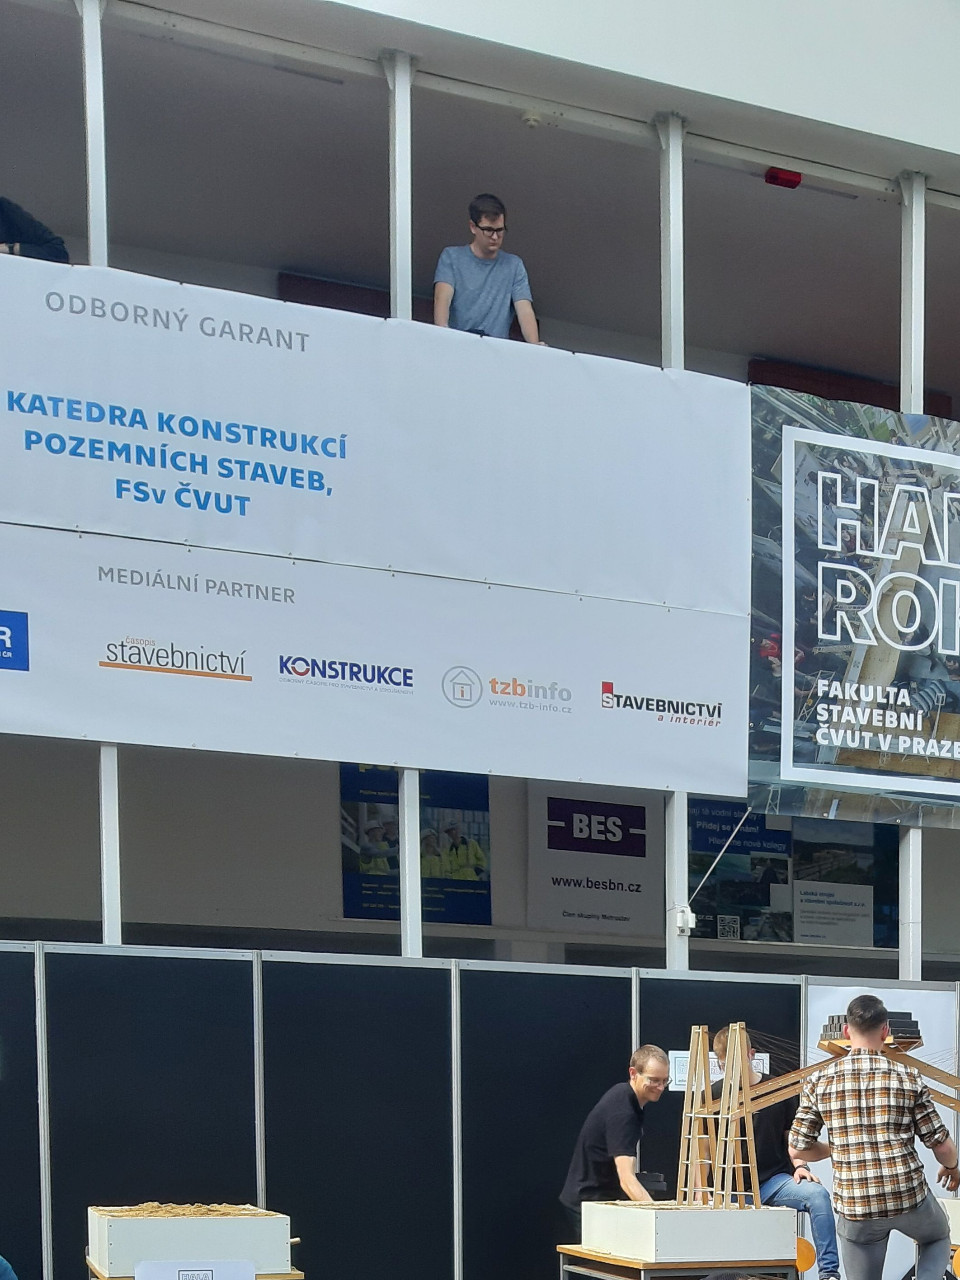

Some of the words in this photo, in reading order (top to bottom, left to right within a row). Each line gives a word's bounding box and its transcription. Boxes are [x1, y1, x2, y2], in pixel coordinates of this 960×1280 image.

[46, 291, 189, 332] ODBORNÝ
[199, 317, 310, 352] GARANT
[7, 390, 148, 430] KATEDRA
[158, 412, 348, 459] KONSTRUKCÍ
[25, 429, 208, 475] POZEMNÍCH
[217, 457, 333, 497] STAVEB,
[116, 478, 166, 505] FSv
[174, 481, 251, 517] ČVUT
[98, 565, 199, 593] MEDIÁLNÍ
[204, 578, 296, 604] PARTNER
[125, 635, 156, 648] časopis
[106, 640, 247, 675] stavebnictví
[279, 655, 413, 687] KONSTRUKCE
[489, 677, 572, 702] tzbinfo
[817, 679, 911, 707] FAKULTA
[489, 699, 572, 714] www.tzb-info.cz
[602, 692, 722, 719] STAVEBNICTVÍ
[816, 703, 923, 731] STAVEBNÍ
[657, 714, 664, 722] a
[669, 713, 721, 728] interiér
[816, 726, 873, 750] ČVUT
[878, 733, 892, 751] V
[572, 813, 623, 842] BES
[551, 876, 642, 893] www.besbn.cz
[182, 1273, 210, 1280] HALA
